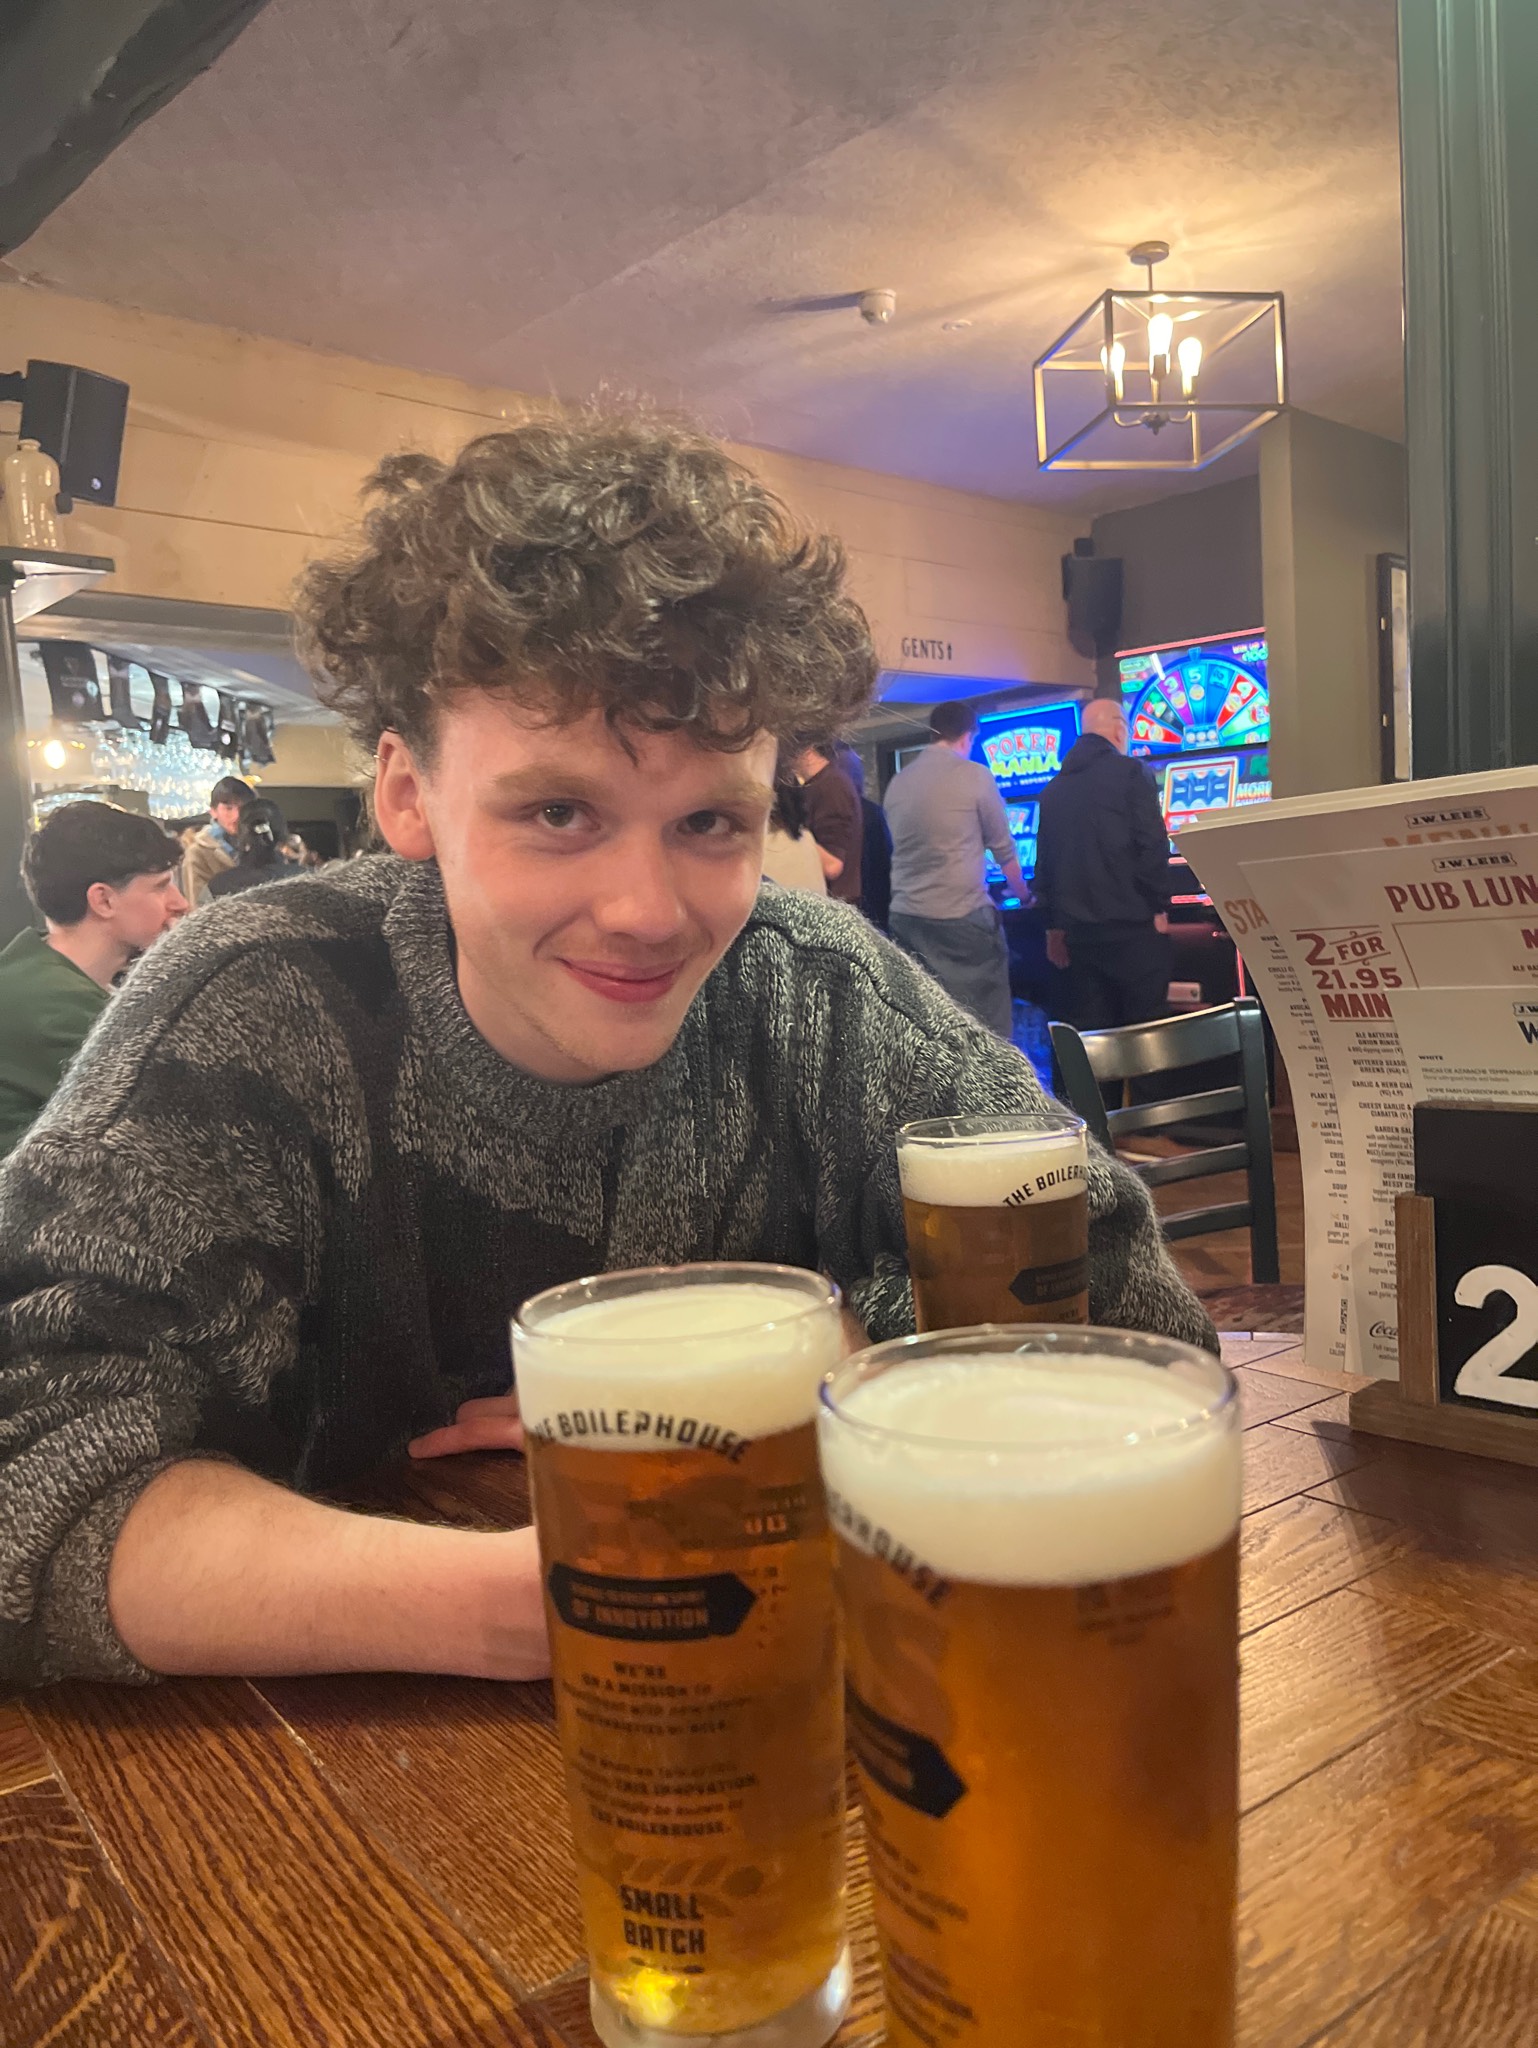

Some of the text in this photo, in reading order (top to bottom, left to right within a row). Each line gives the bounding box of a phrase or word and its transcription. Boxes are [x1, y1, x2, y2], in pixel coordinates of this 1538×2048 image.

[901, 637, 944, 660] GENTS
[1188, 669, 1201, 681] 5
[986, 734, 1057, 762] POKER
[990, 751, 1061, 778] MANIA
[1384, 875, 1538, 913] PUB LUN
[1224, 898, 1269, 934] STA
[1296, 933, 1385, 966] 2 FOR
[1312, 968, 1403, 990] 21.95
[1320, 993, 1392, 1018] MAIN
[1002, 1182, 1035, 1209] THE
[1454, 1264, 1538, 1410] 2
[620, 1885, 704, 1920] SMALL
[624, 1919, 706, 1956] BATCH
